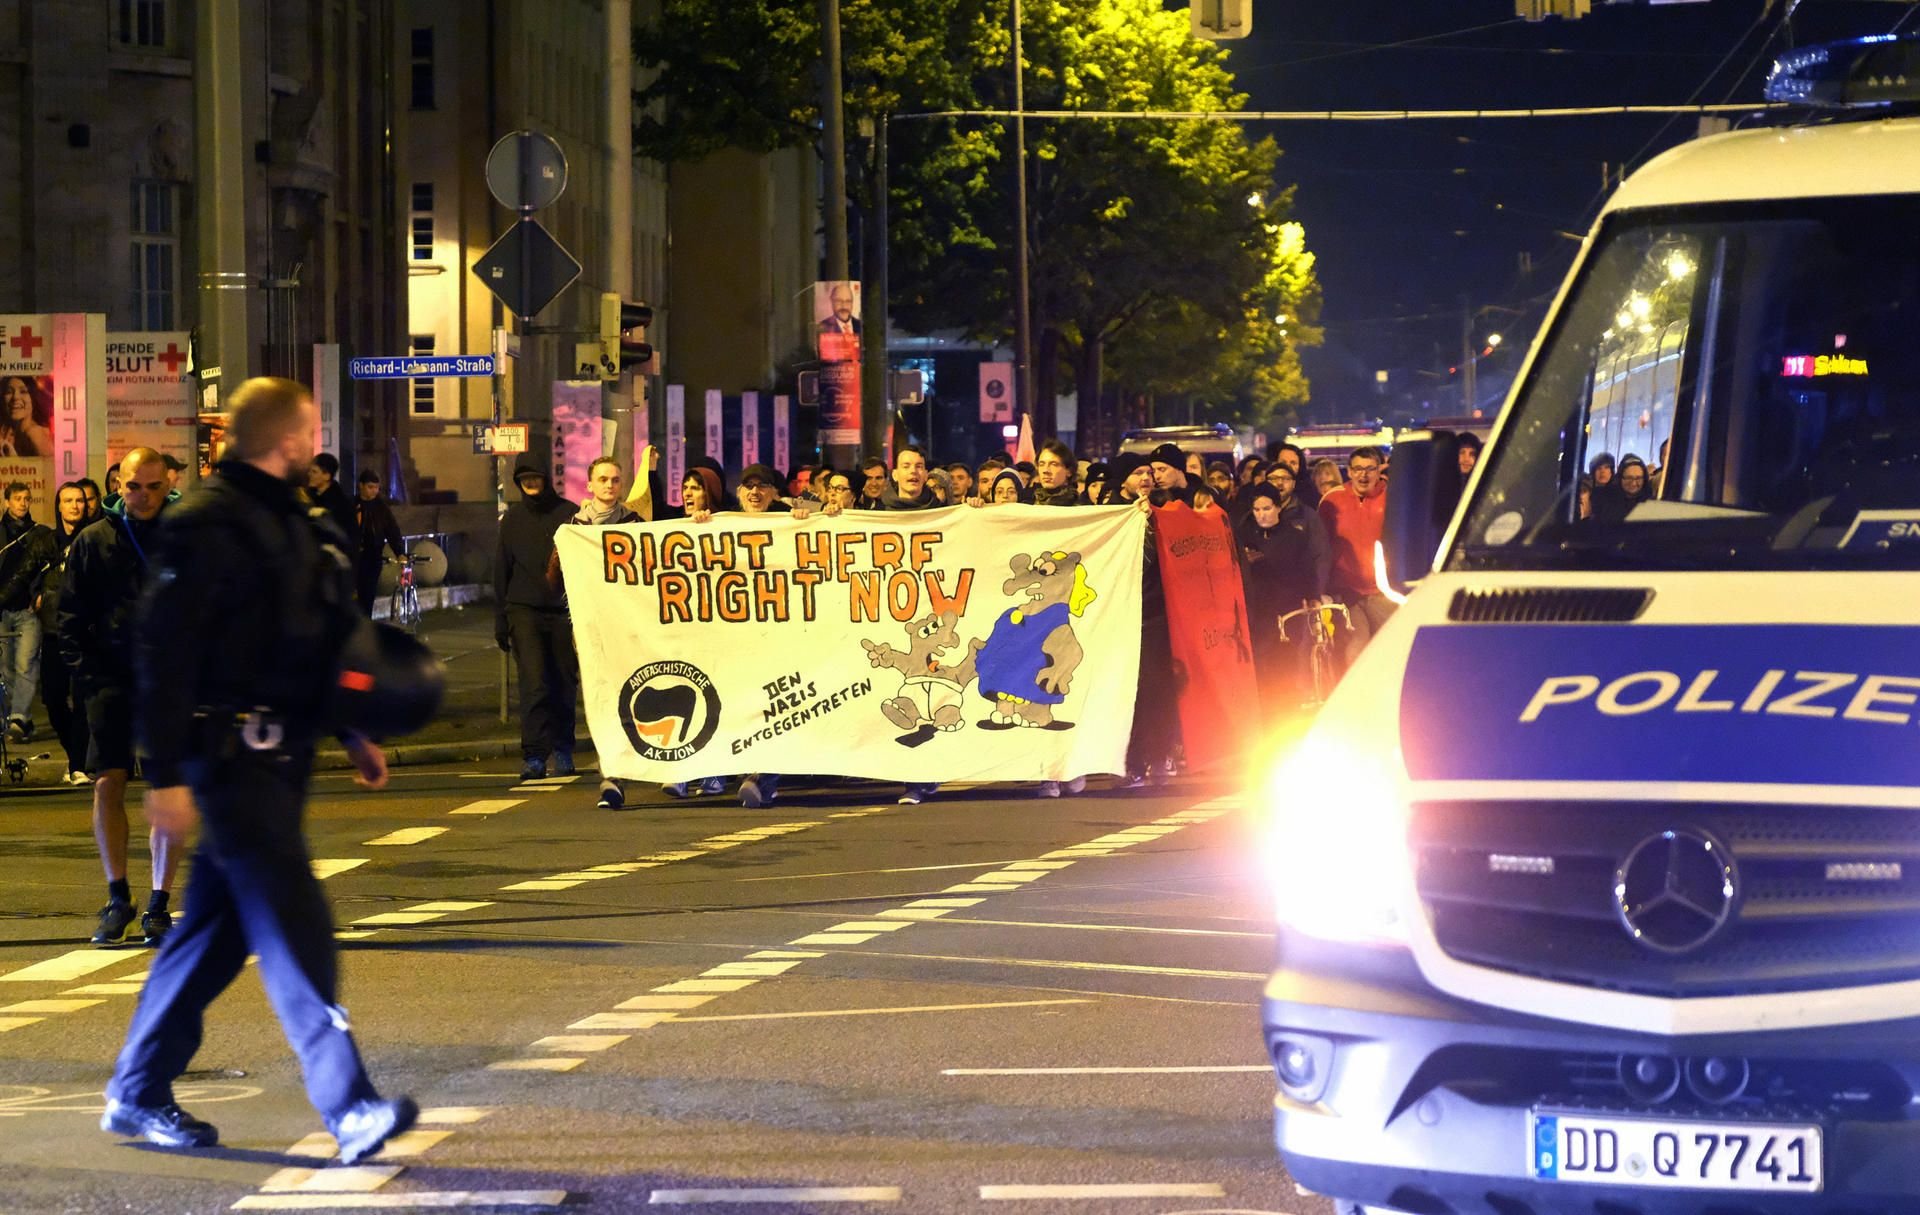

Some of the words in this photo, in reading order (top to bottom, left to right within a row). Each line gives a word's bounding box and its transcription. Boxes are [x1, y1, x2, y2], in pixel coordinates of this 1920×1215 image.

[0, 465, 37, 475] etten
[602, 531, 773, 585] RIGHT
[796, 531, 943, 582] HERE
[657, 568, 824, 624] RIGHT
[850, 568, 975, 622] NOW
[629, 662, 711, 691] ANTIFASCHISTISCHE
[762, 671, 801, 700] DEN
[1518, 669, 1920, 725] POLIZE
[731, 678, 872, 756] ENTGEGENTRETEN
[763, 681, 817, 723] NAZIS
[644, 744, 696, 762] AKTION
[1564, 1127, 1619, 1173] DD
[1653, 1132, 1680, 1177] Q
[1695, 1134, 1813, 1183] 7741
